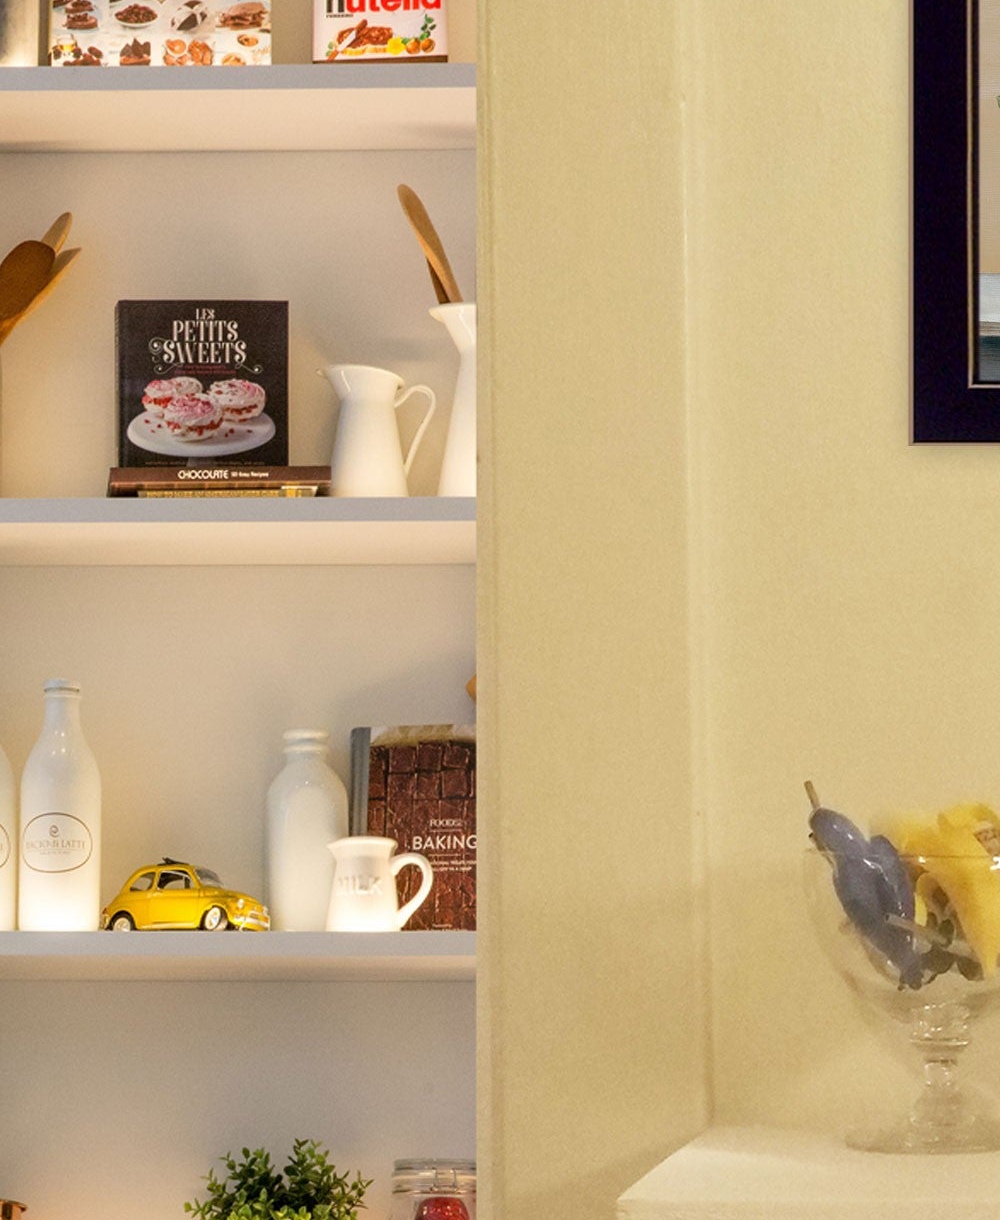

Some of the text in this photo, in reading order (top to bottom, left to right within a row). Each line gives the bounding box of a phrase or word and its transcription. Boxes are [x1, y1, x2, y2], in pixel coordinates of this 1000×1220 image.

[196, 308, 215, 321] LES
[172, 320, 239, 342] PETITS
[163, 340, 248, 364] SWEETS
[177, 469, 229, 479] CHOCOLATE
[412, 834, 477, 849] BAKING
[335, 875, 384, 896] MILK
